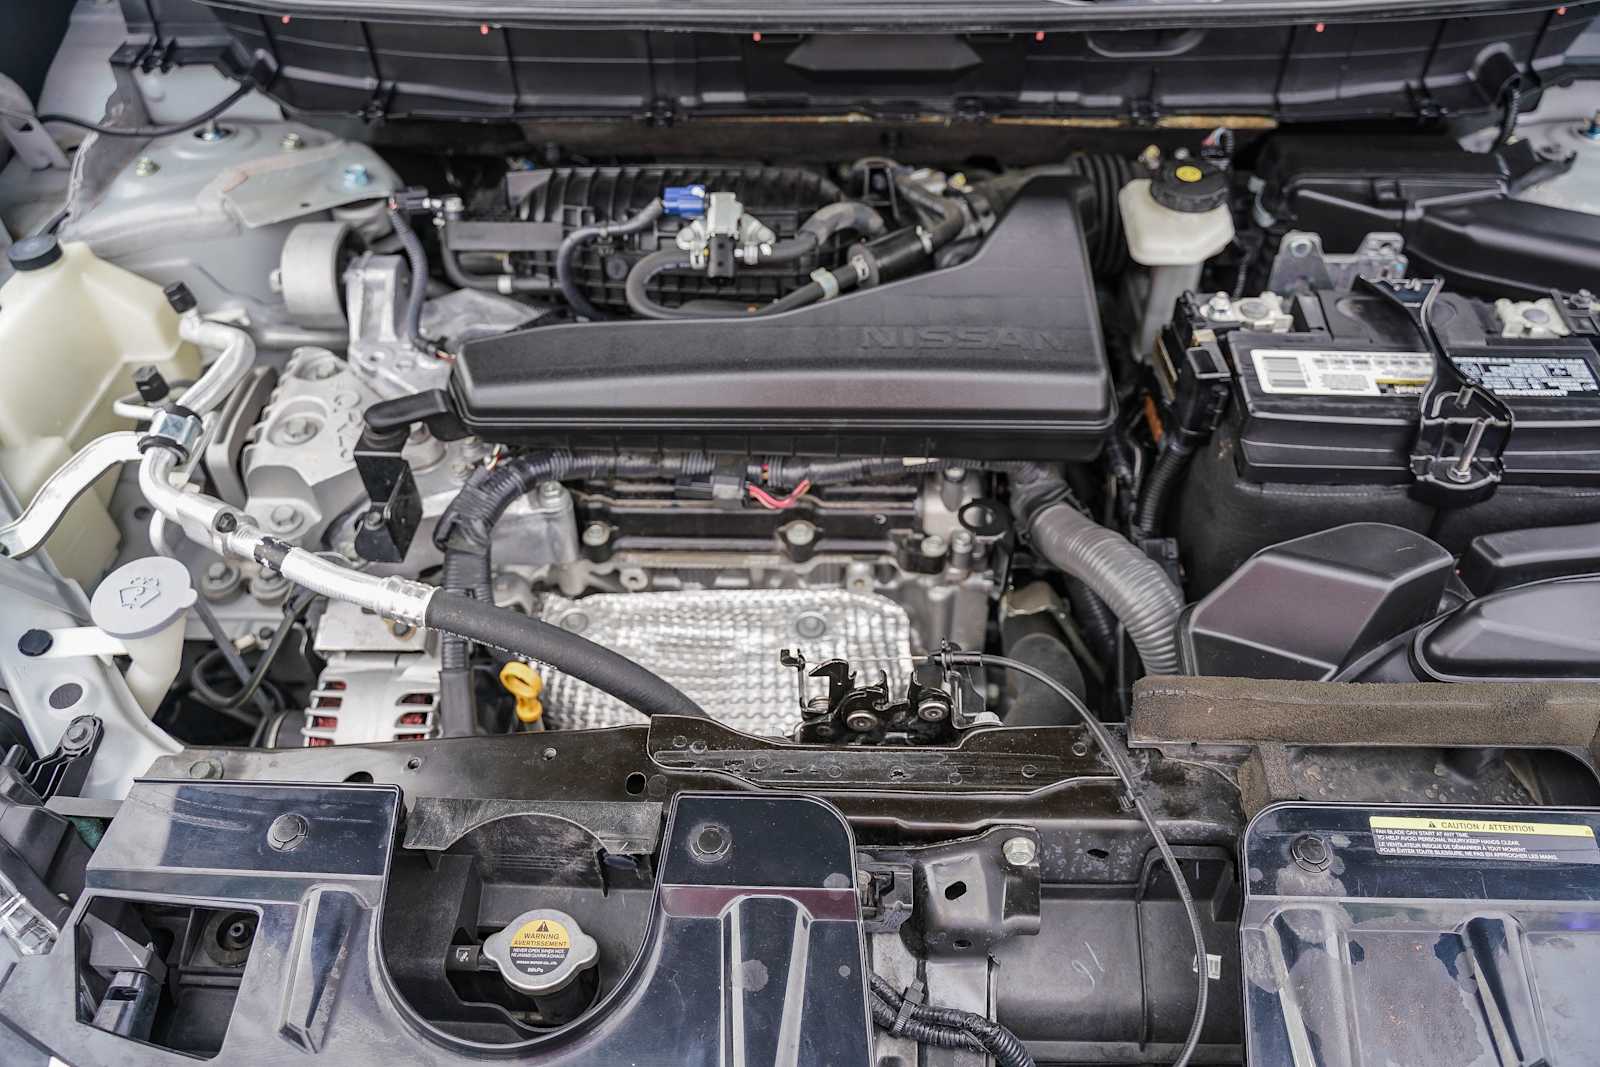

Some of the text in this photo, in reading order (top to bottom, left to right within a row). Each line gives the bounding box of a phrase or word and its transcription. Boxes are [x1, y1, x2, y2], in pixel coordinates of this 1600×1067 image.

[860, 326, 1068, 352] NISSAN
[1441, 822, 1479, 830] CAUTION
[1488, 824, 1535, 832] ATTENTION
